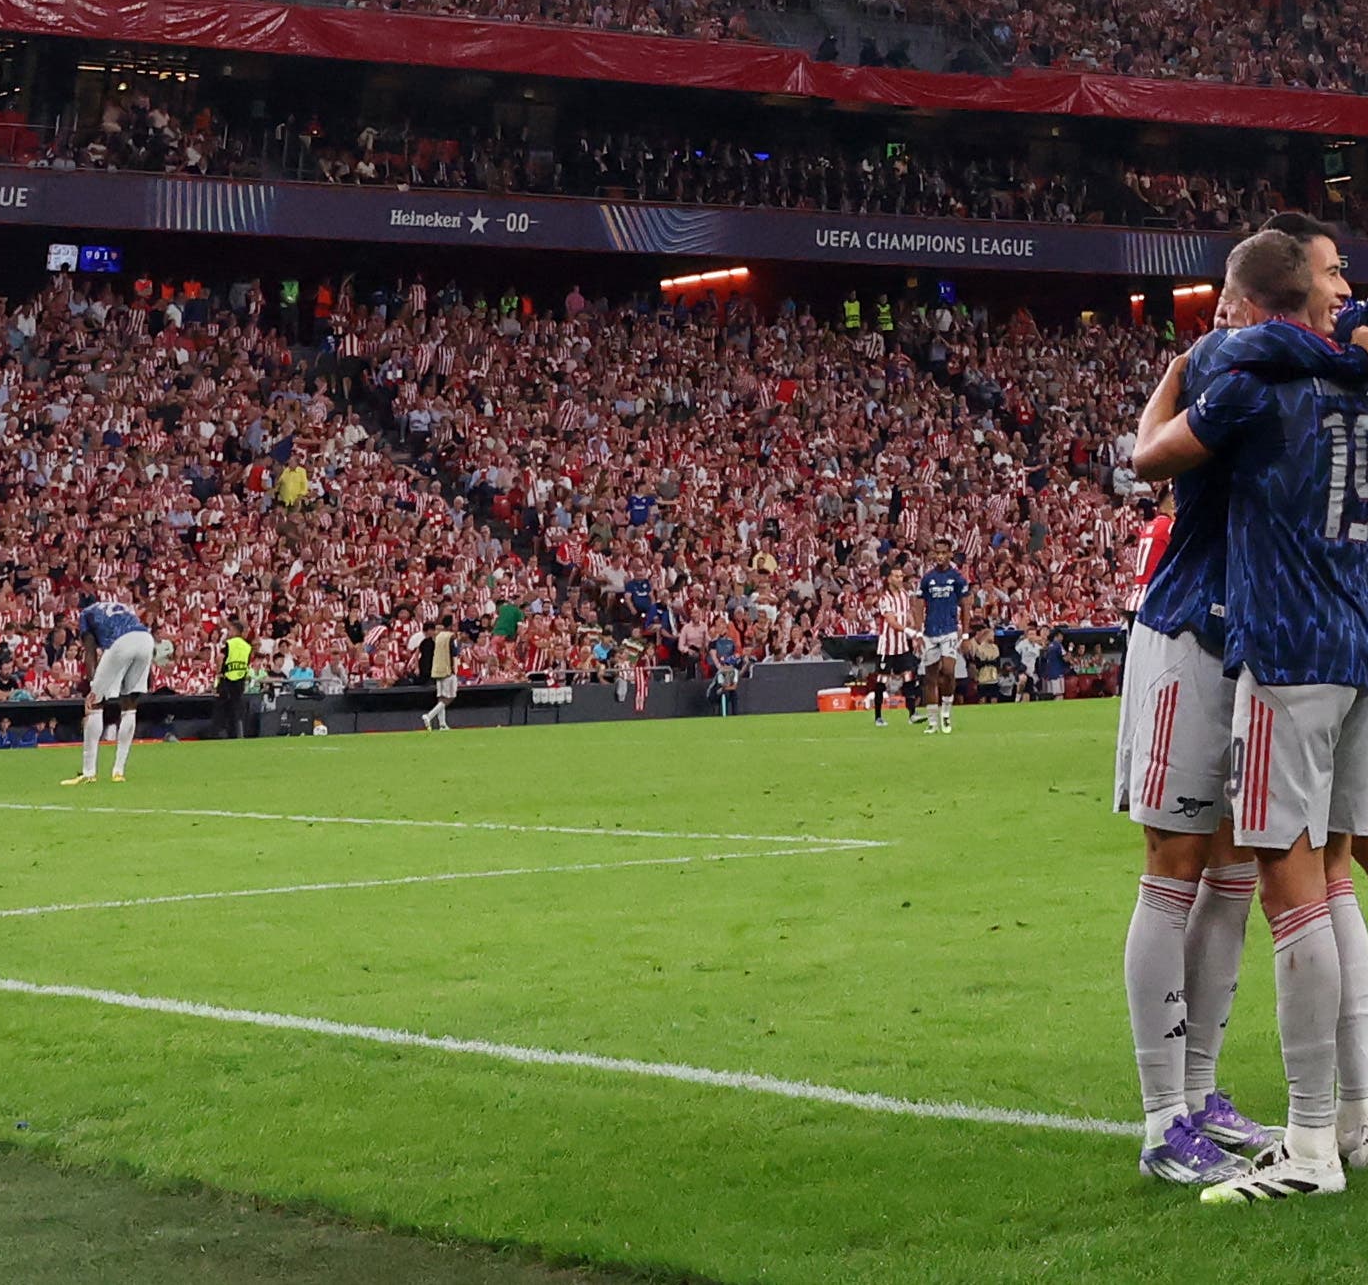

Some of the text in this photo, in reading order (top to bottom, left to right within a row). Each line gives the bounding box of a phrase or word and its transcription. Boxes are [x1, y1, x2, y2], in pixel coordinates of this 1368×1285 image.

[390, 209, 462, 228] Heineken
[816, 229, 1033, 257] UEFA CHAMPIONS LEAGUE
[1164, 990, 1186, 1004] AF
